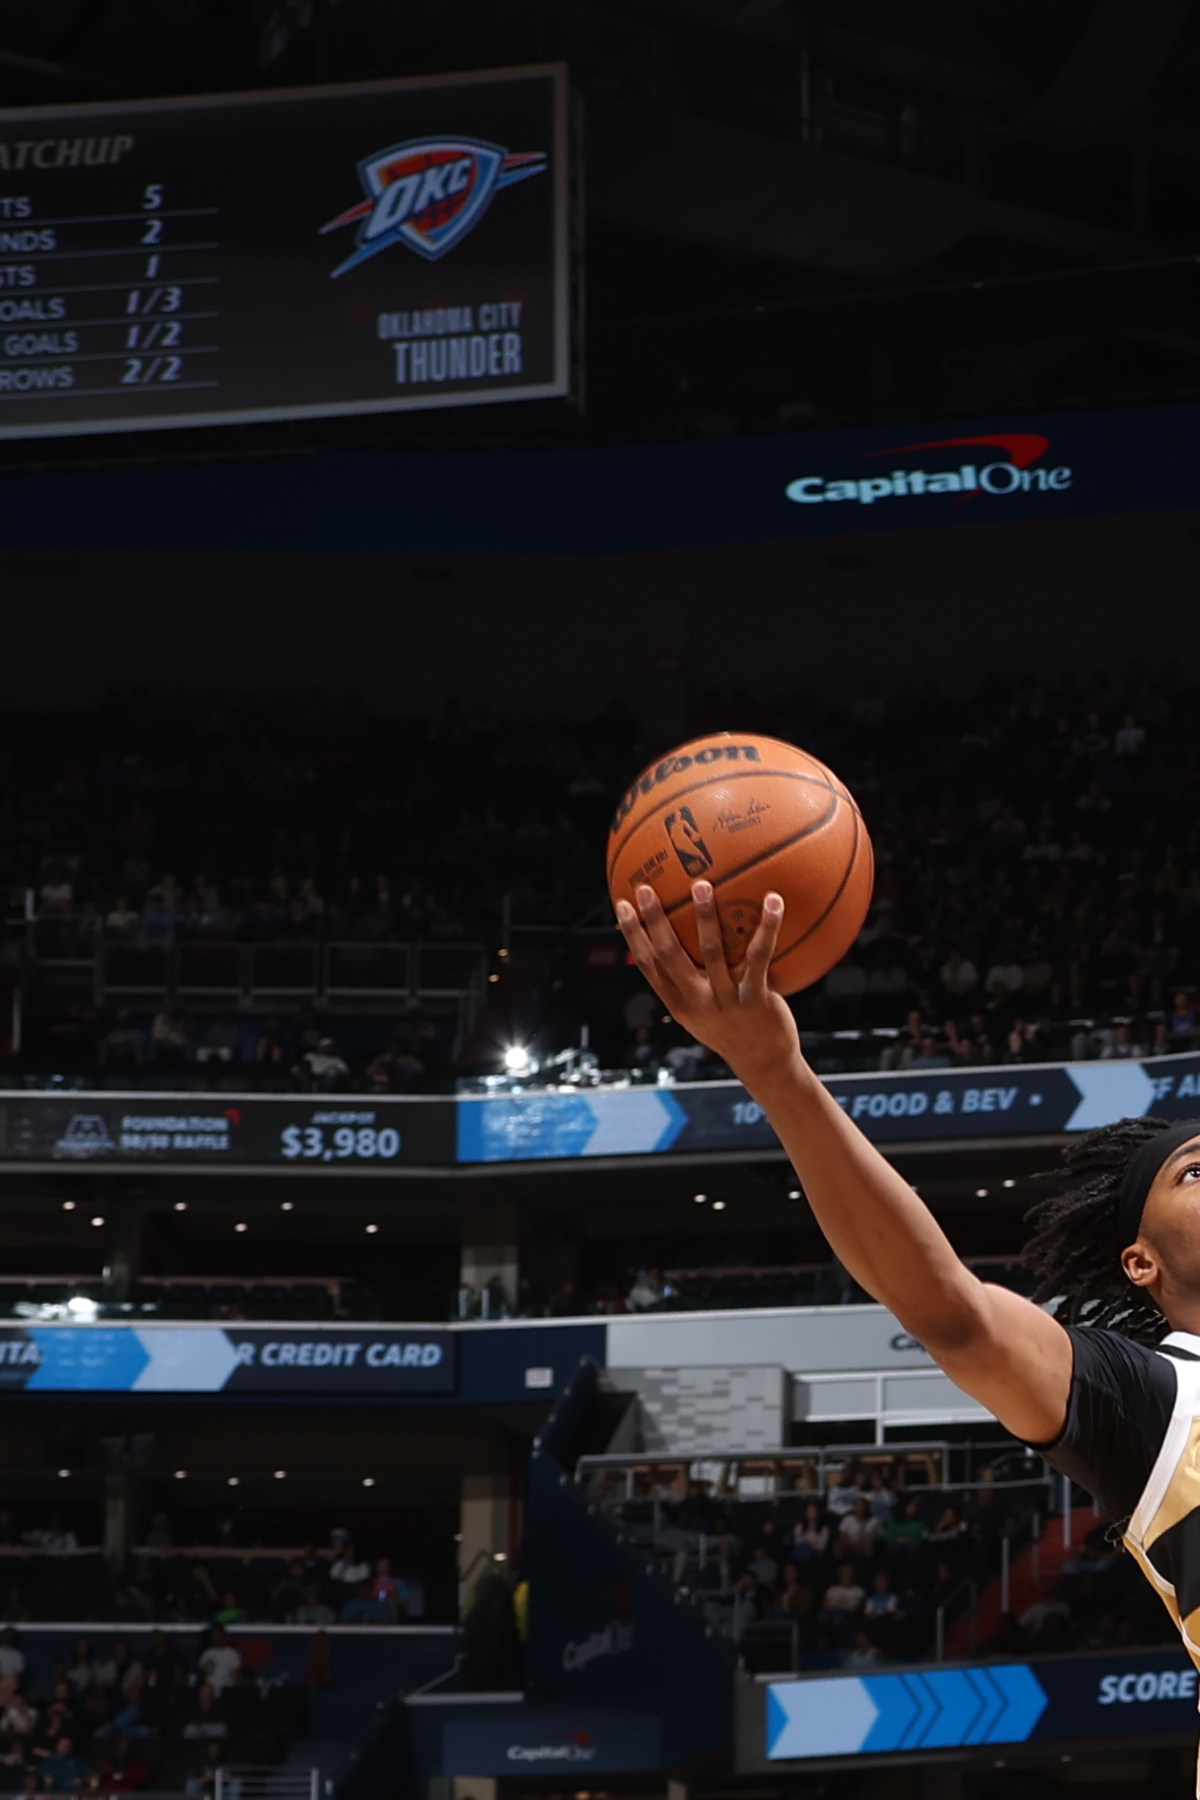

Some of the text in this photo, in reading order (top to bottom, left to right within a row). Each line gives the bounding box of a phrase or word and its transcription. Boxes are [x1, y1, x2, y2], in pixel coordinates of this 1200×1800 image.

[142, 183, 165, 210] 5
[364, 156, 474, 241] OKC
[139, 218, 165, 245] 2
[145, 254, 161, 279] 1
[125, 286, 183, 315] 1/3
[125, 320, 183, 350] 1/2
[377, 301, 523, 341] OKLAHOMA CITY
[3, 331, 79, 356] GOALS
[392, 331, 524, 385] THUNDER
[120, 355, 183, 385] 2/2
[852, 1091, 928, 1118] FOOD
[933, 1090, 955, 1115] &
[961, 1086, 1019, 1113] BEV
[280, 1124, 401, 1162] $3,980
[261, 1343, 360, 1367] CREDIT
[366, 1343, 441, 1367] CARD
[1099, 1669, 1198, 1704] SCORE
